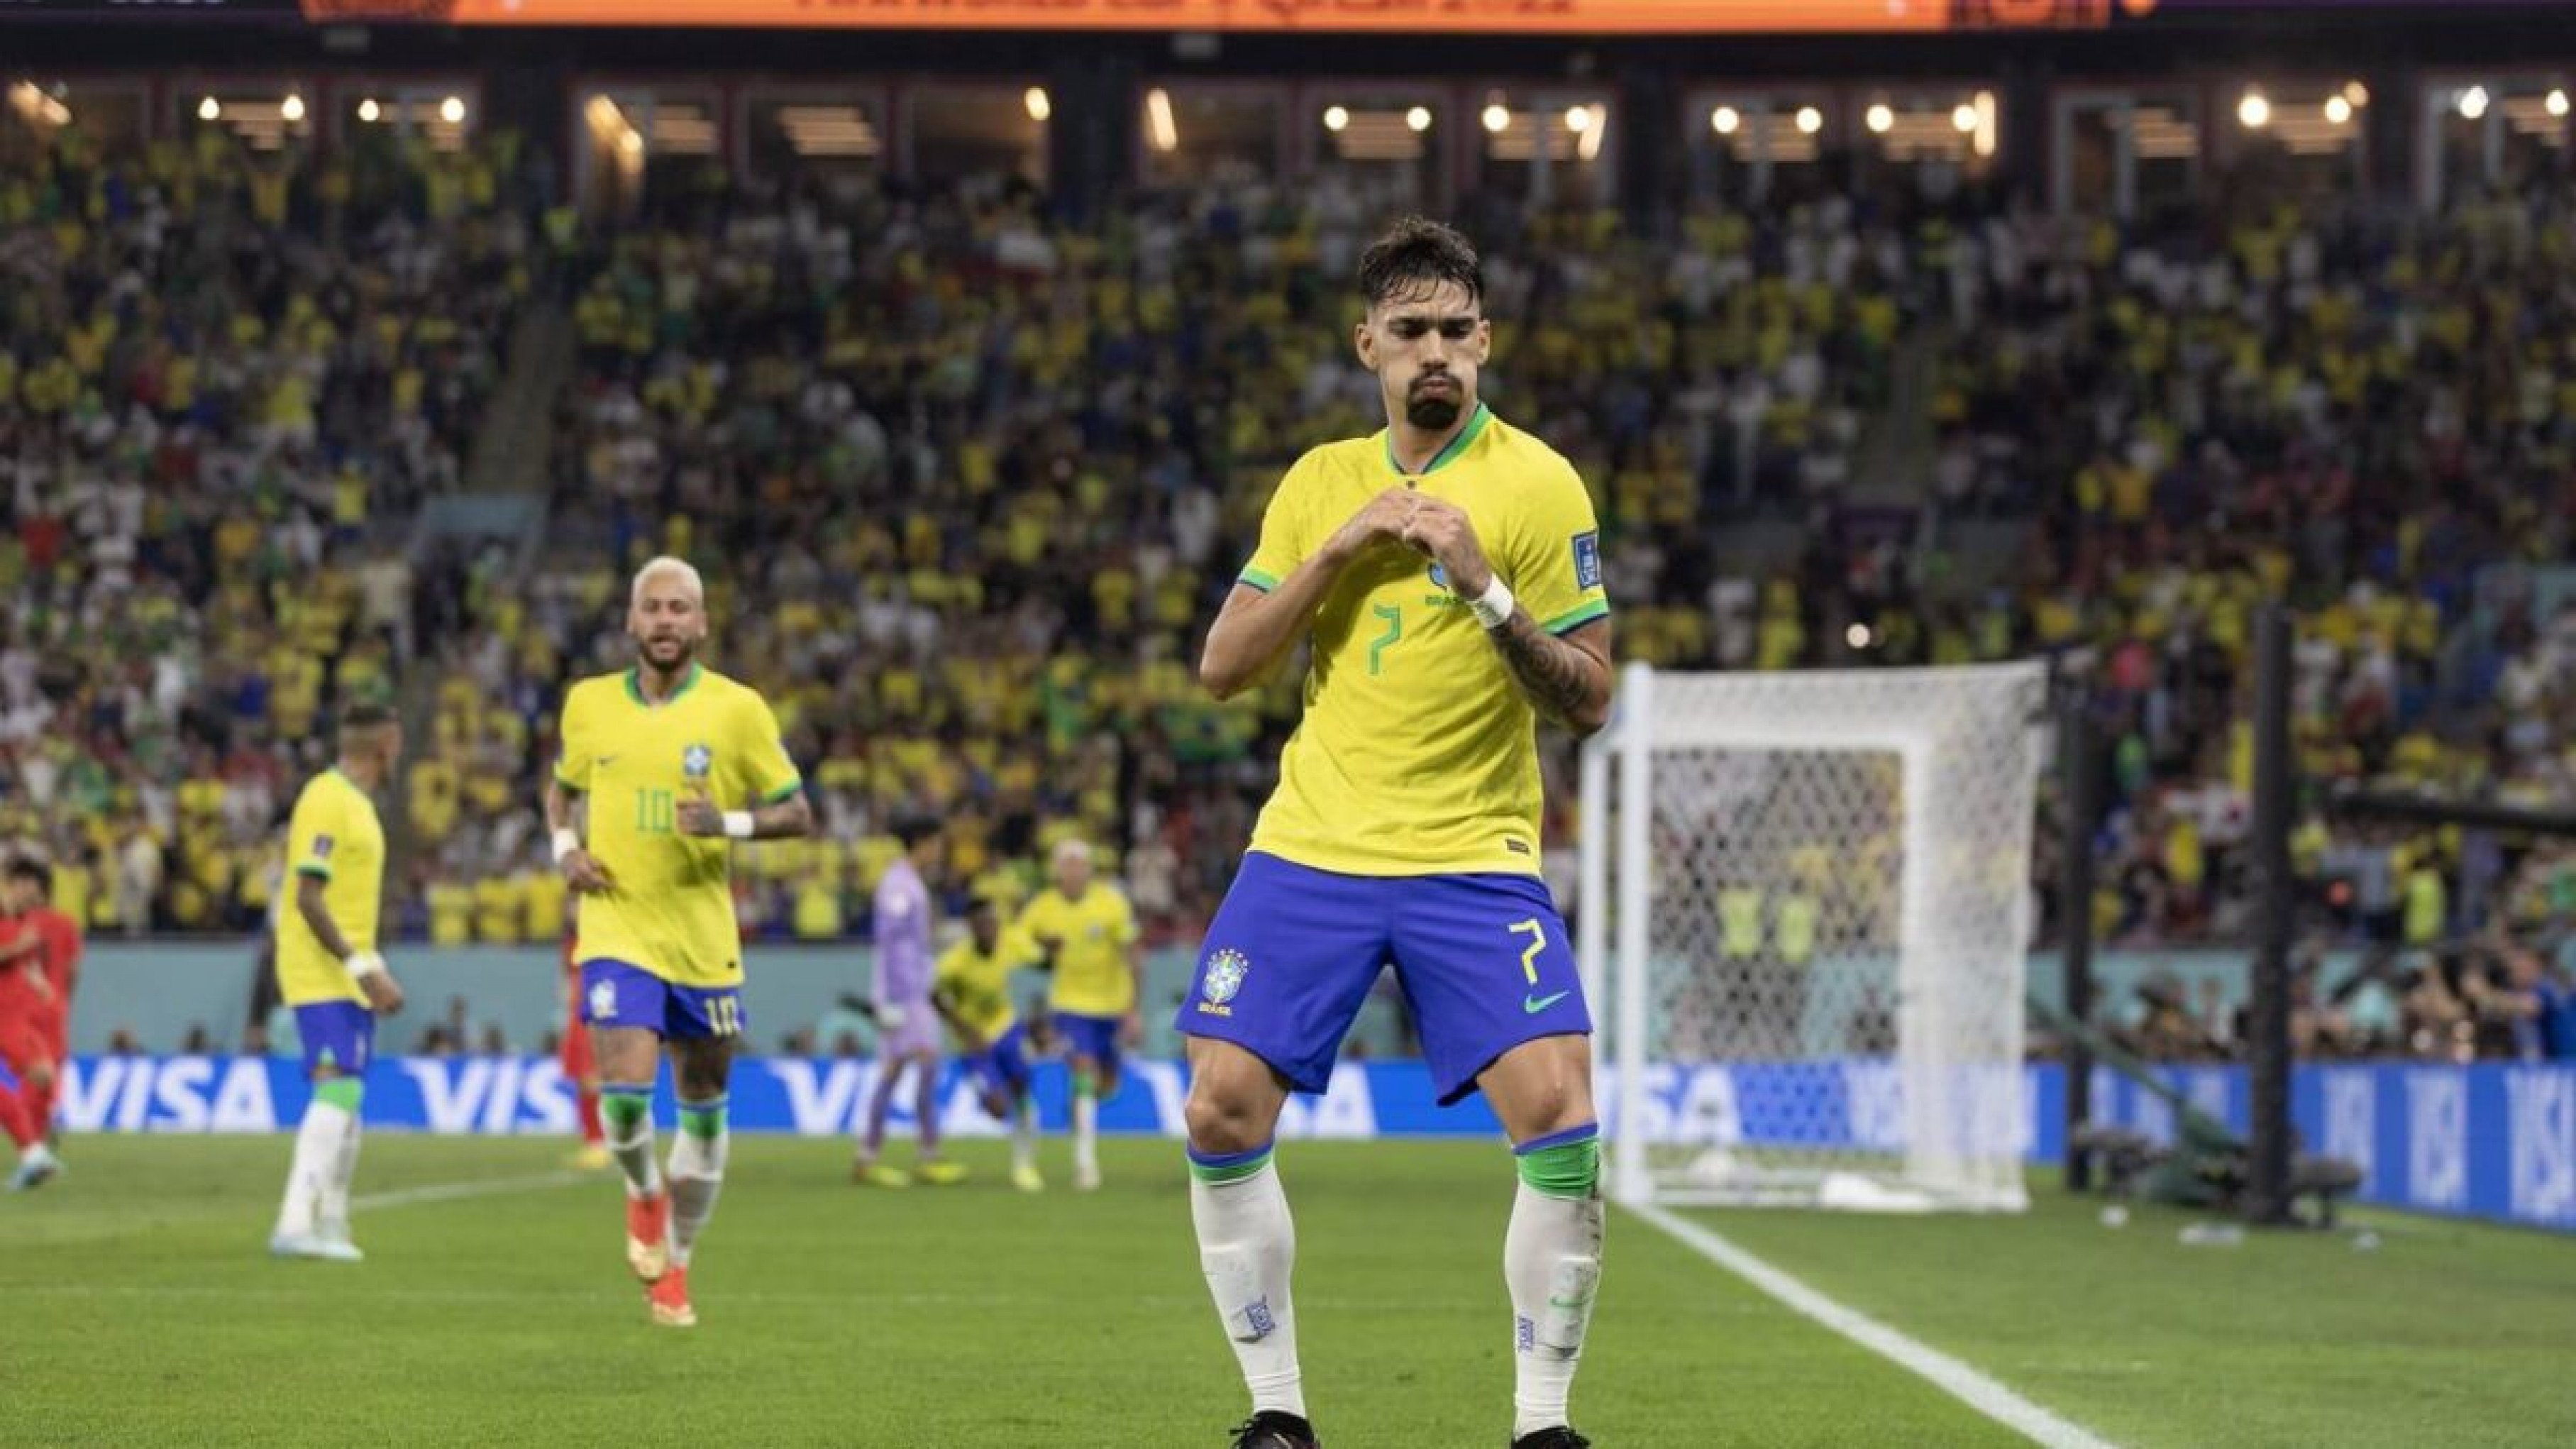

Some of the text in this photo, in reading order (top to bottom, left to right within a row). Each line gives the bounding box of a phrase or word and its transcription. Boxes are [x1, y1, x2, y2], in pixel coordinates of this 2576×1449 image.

[1369, 604, 1400, 676] 7
[636, 788, 671, 833] 10
[1508, 919, 1546, 984] 7
[704, 996, 741, 1035] 10
[57, 1055, 278, 1133] VISA
[399, 1055, 583, 1135] VIS
